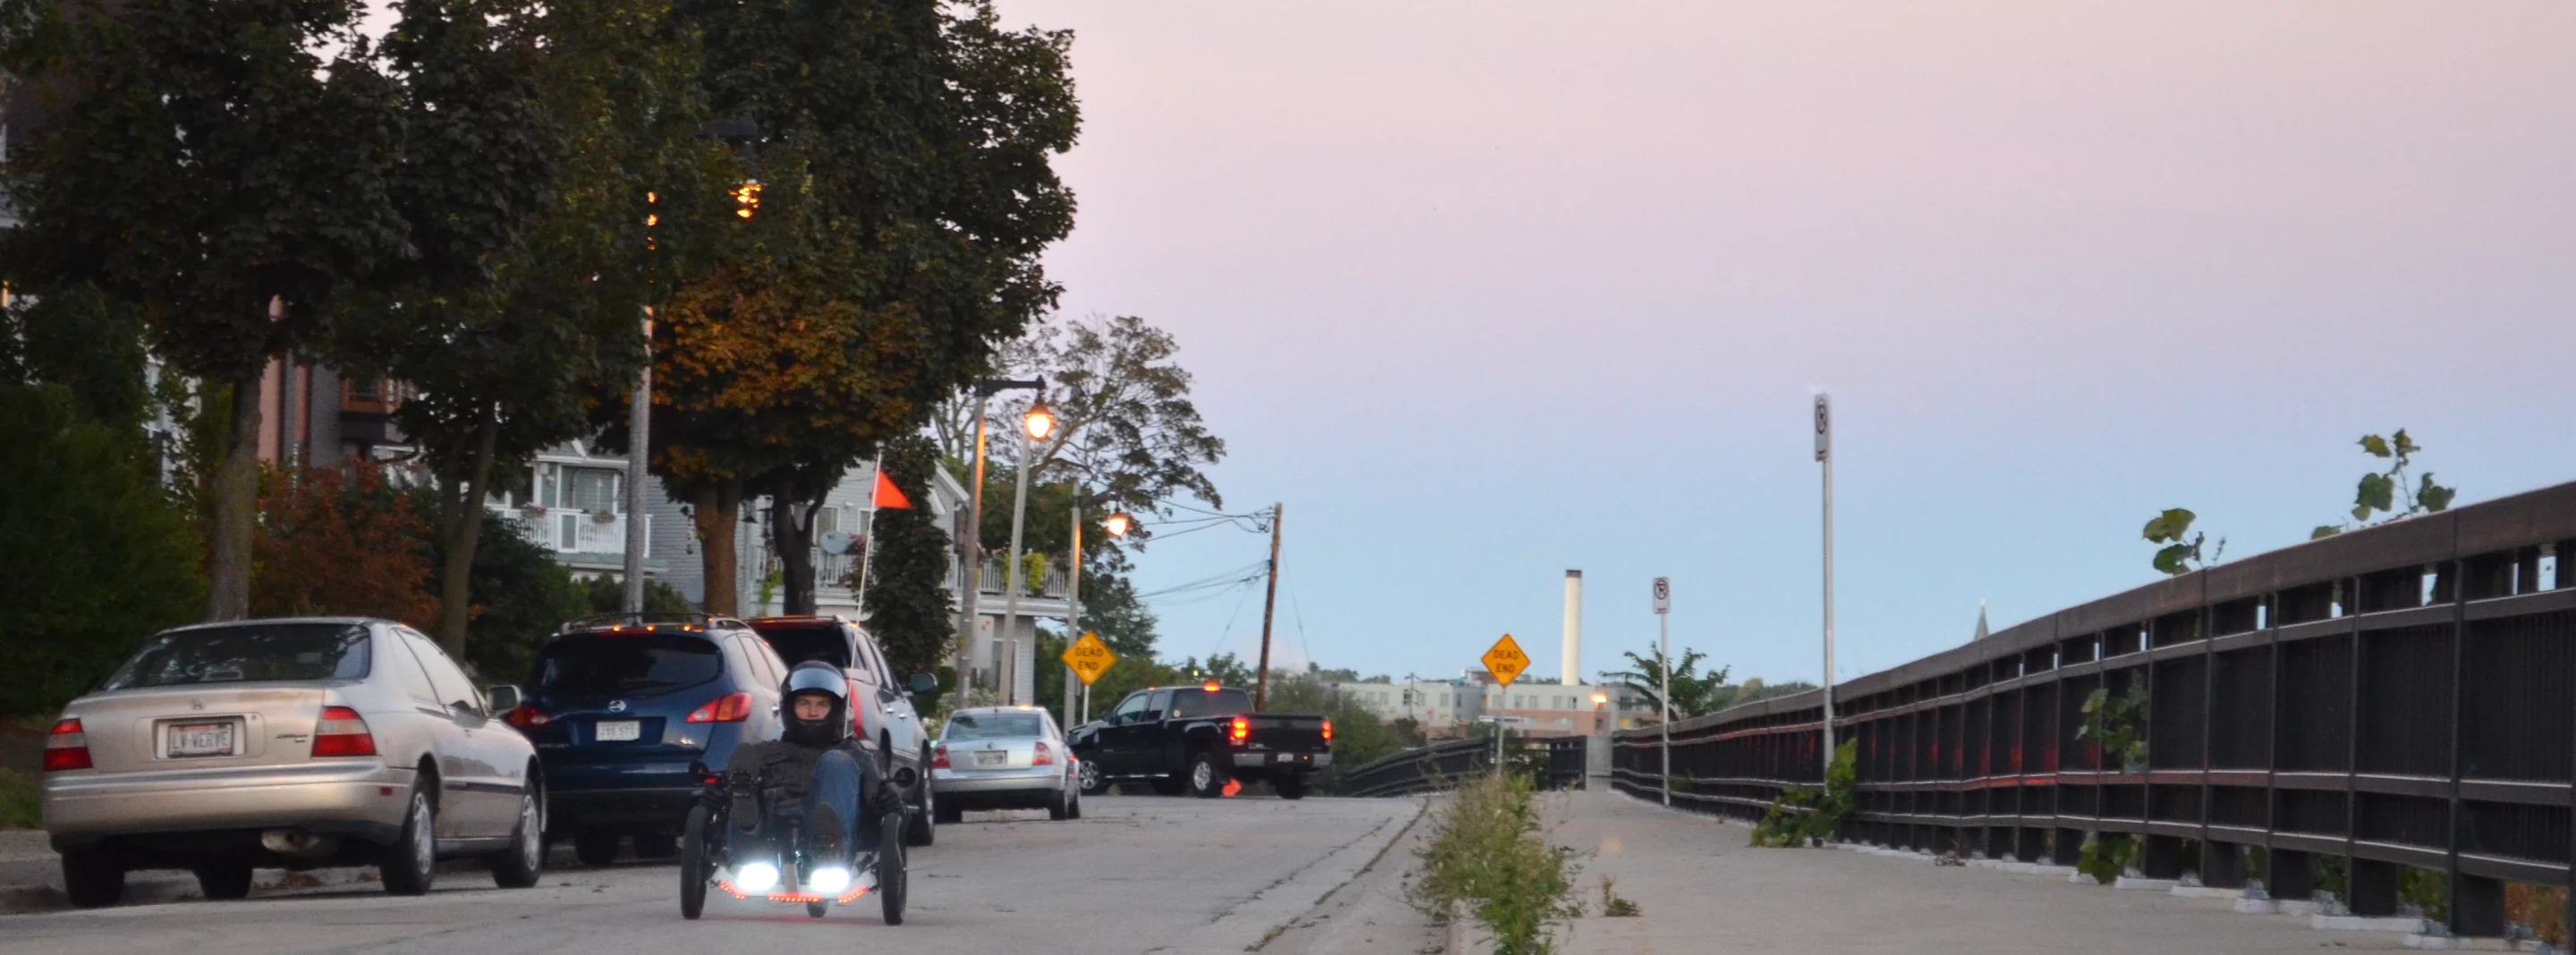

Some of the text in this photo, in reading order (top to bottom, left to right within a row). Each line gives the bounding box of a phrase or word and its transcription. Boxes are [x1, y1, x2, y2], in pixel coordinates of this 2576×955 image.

[1075, 647, 1104, 656] DEAD
[1494, 650, 1519, 660] DEAD
[1078, 661, 1100, 671] END
[1496, 663, 1515, 672] END
